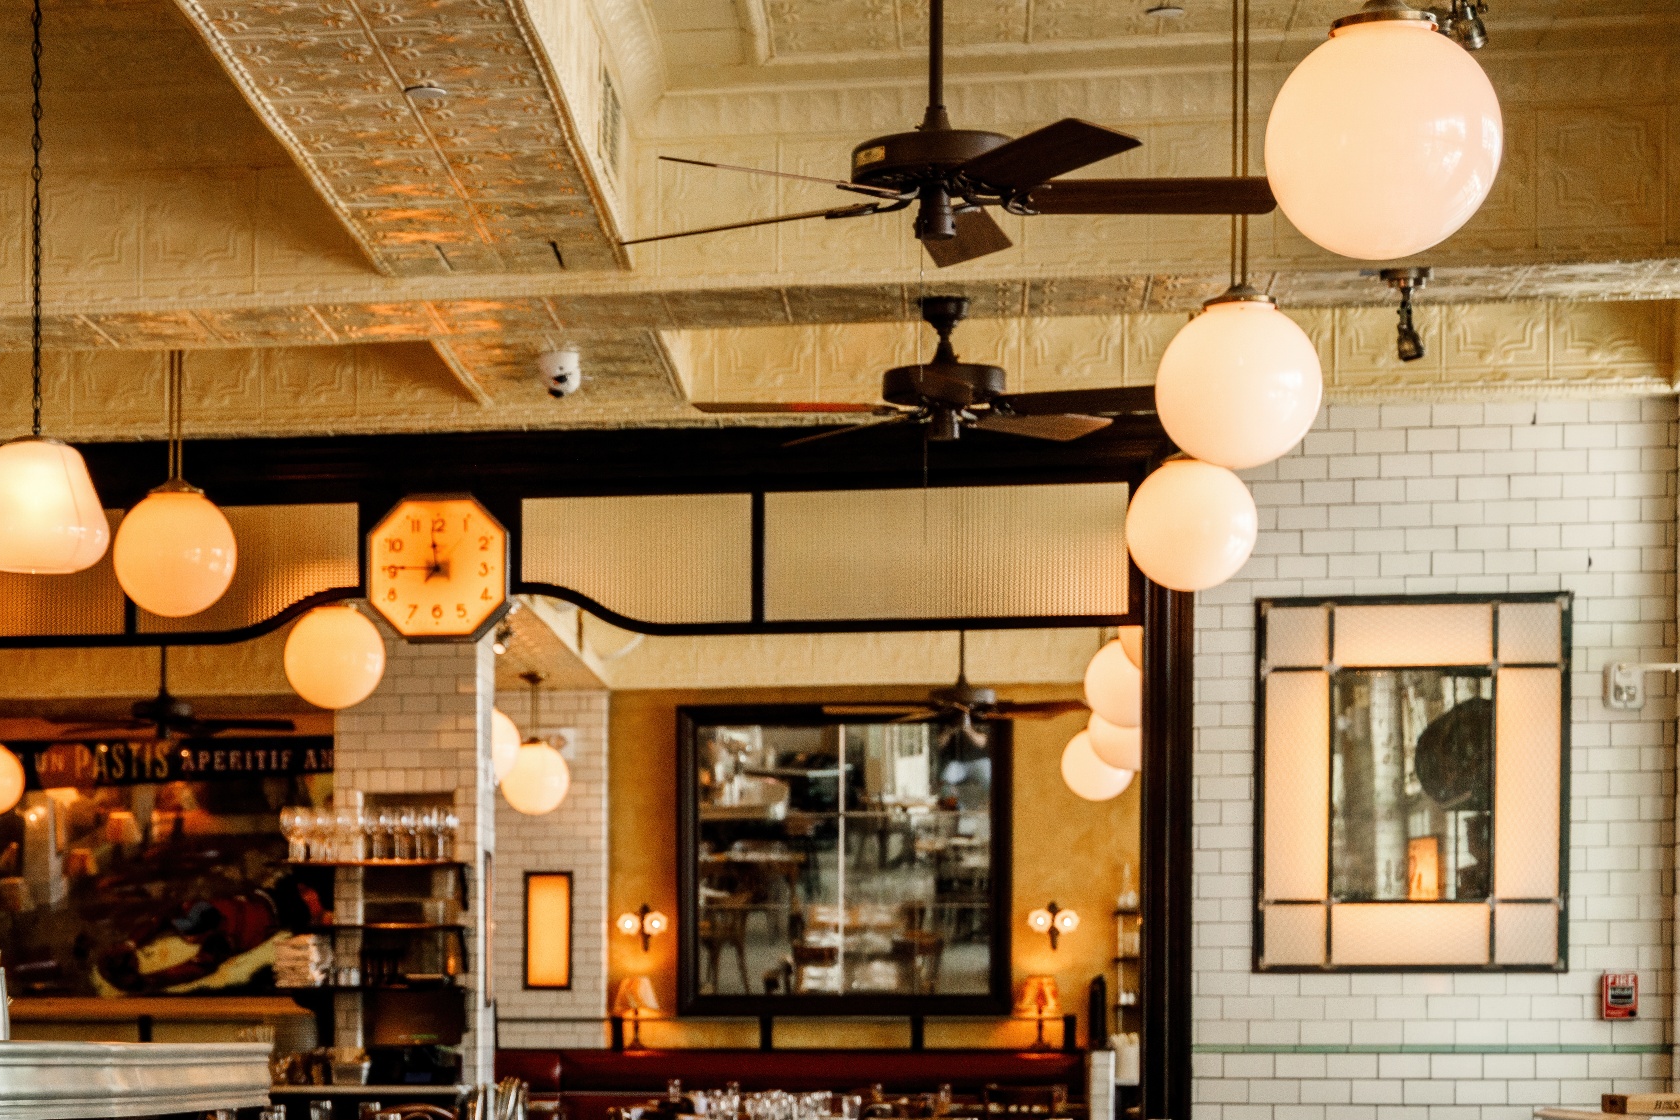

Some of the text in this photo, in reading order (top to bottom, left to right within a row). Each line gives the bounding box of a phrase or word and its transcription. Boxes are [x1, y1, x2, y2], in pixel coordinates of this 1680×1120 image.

[411, 520, 421, 532] 11
[431, 519, 445, 532] 12
[389, 539, 403, 552] 10
[479, 536, 488, 550] 2
[388, 566, 397, 578] 9
[479, 563, 488, 576] 3
[387, 588, 397, 601] 8
[480, 588, 490, 600] 4
[408, 605, 418, 619] 7
[431, 605, 443, 618] 6
[456, 604, 466, 618] 5
[74, 743, 169, 778] PASTIS
[1608, 975, 1635, 986] FIRE
